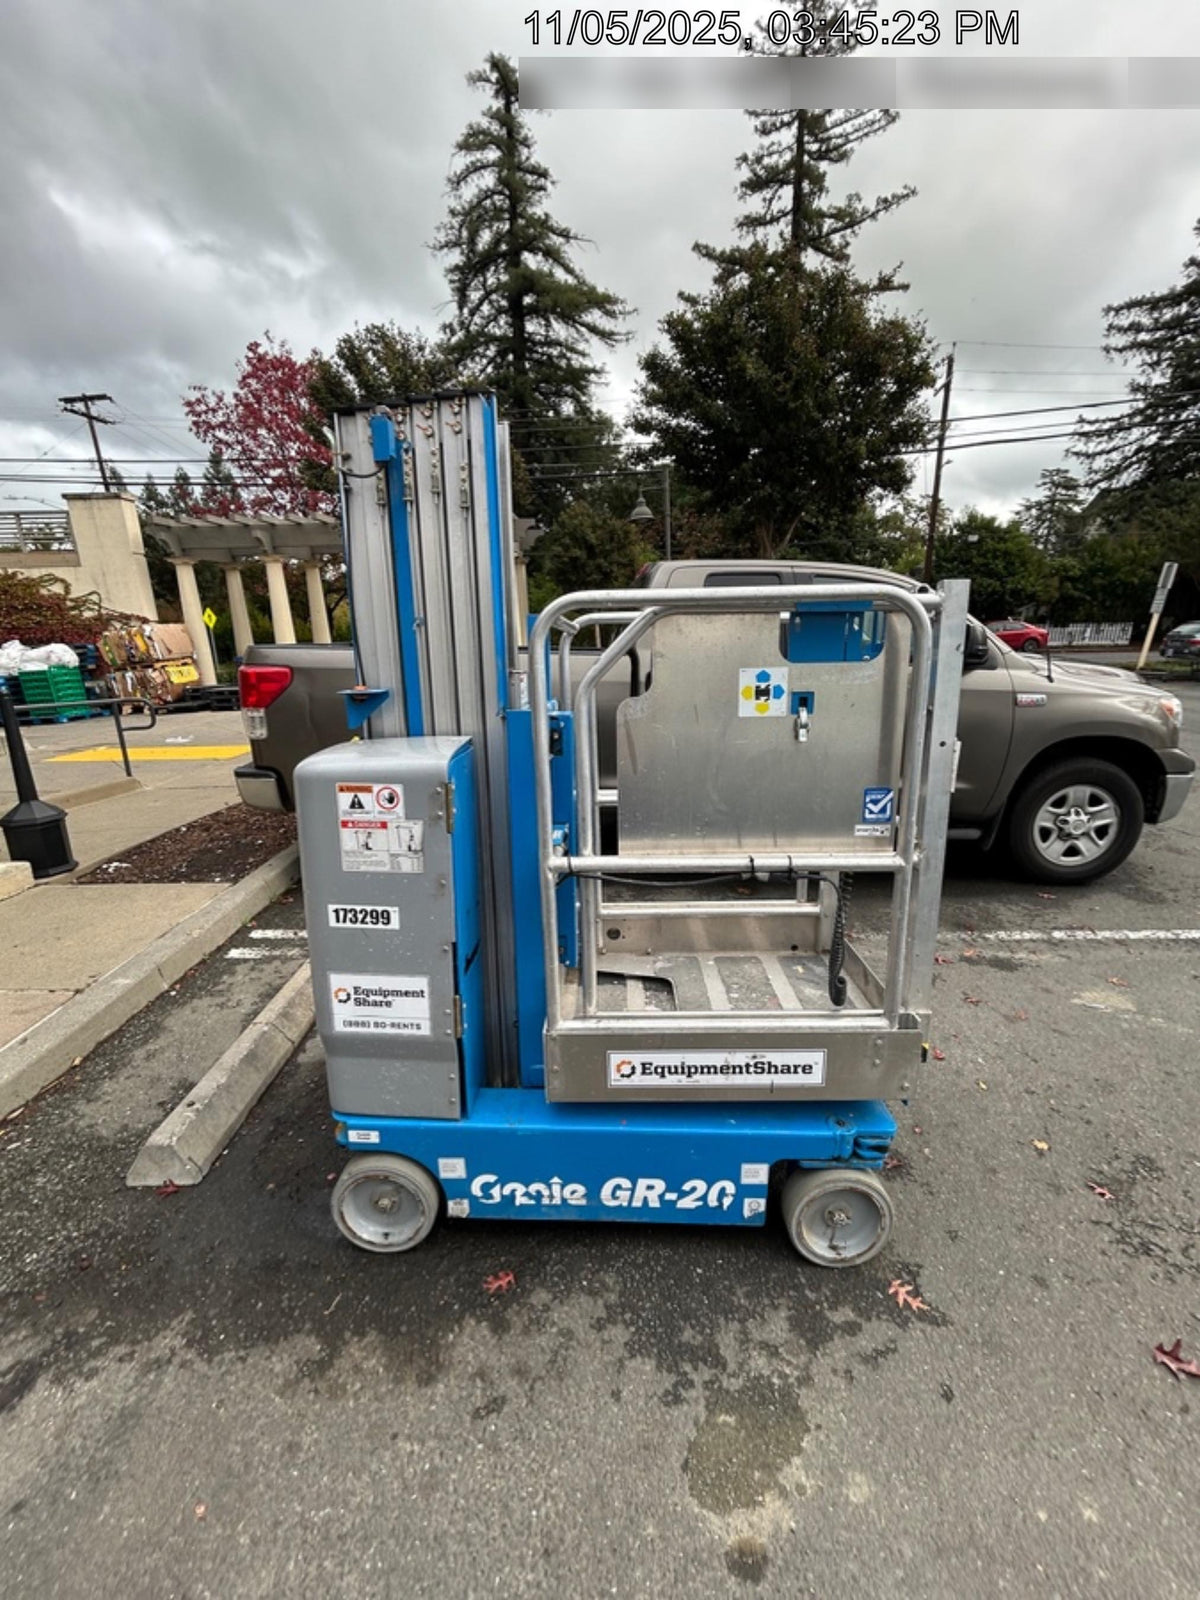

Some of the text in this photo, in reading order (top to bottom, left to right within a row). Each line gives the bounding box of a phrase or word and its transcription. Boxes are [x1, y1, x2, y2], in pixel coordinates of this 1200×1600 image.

[332, 907, 391, 926] 173299
[353, 986, 425, 998] Equipment
[353, 997, 393, 1008] Share
[640, 1061, 814, 1079] EquipmentShare
[600, 1177, 736, 1211] GR-20
